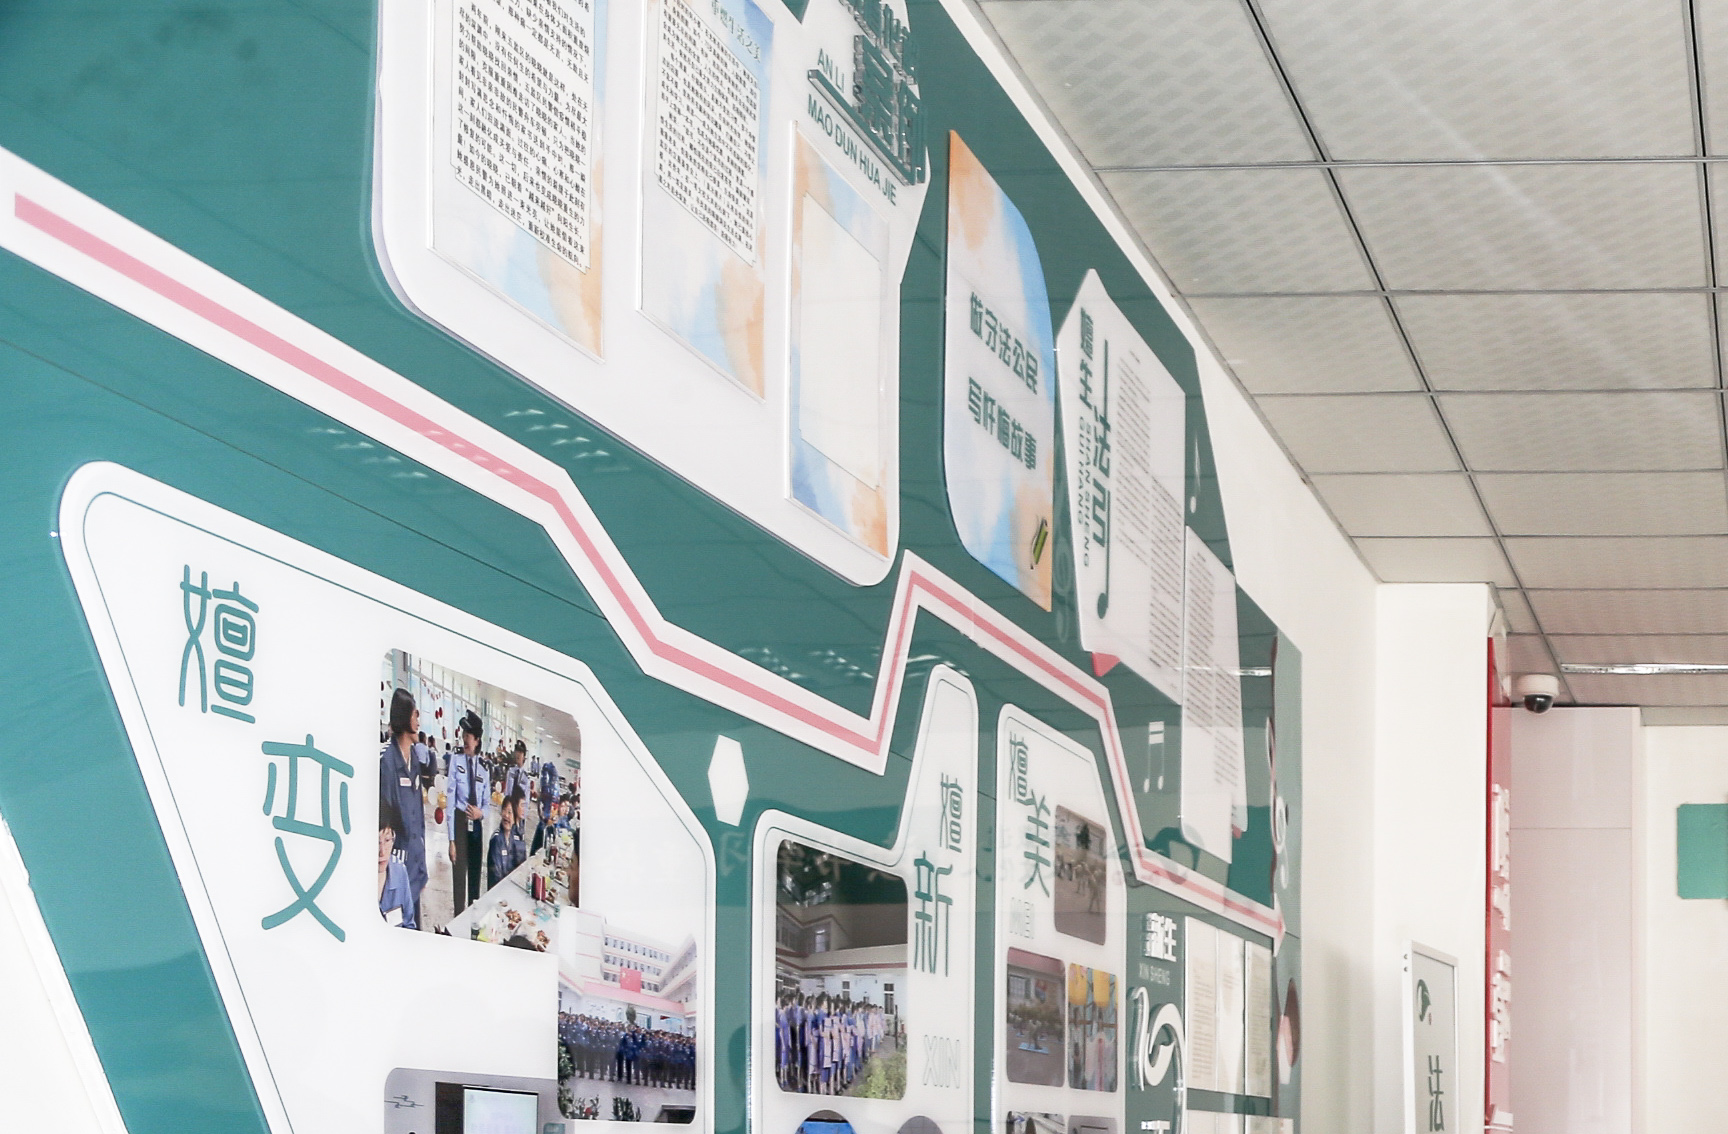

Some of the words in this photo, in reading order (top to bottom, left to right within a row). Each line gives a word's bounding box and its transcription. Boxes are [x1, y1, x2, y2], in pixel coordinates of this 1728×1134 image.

[817, 48, 833, 76] AN
[835, 66, 845, 93] LI
[808, 94, 833, 137] MAO
[835, 123, 857, 164] DUN
[859, 150, 881, 189] HUA
[882, 178, 897, 206] JIE
[970, 291, 1038, 395] 做守法公民
[923, 1035, 961, 1089] XIN
